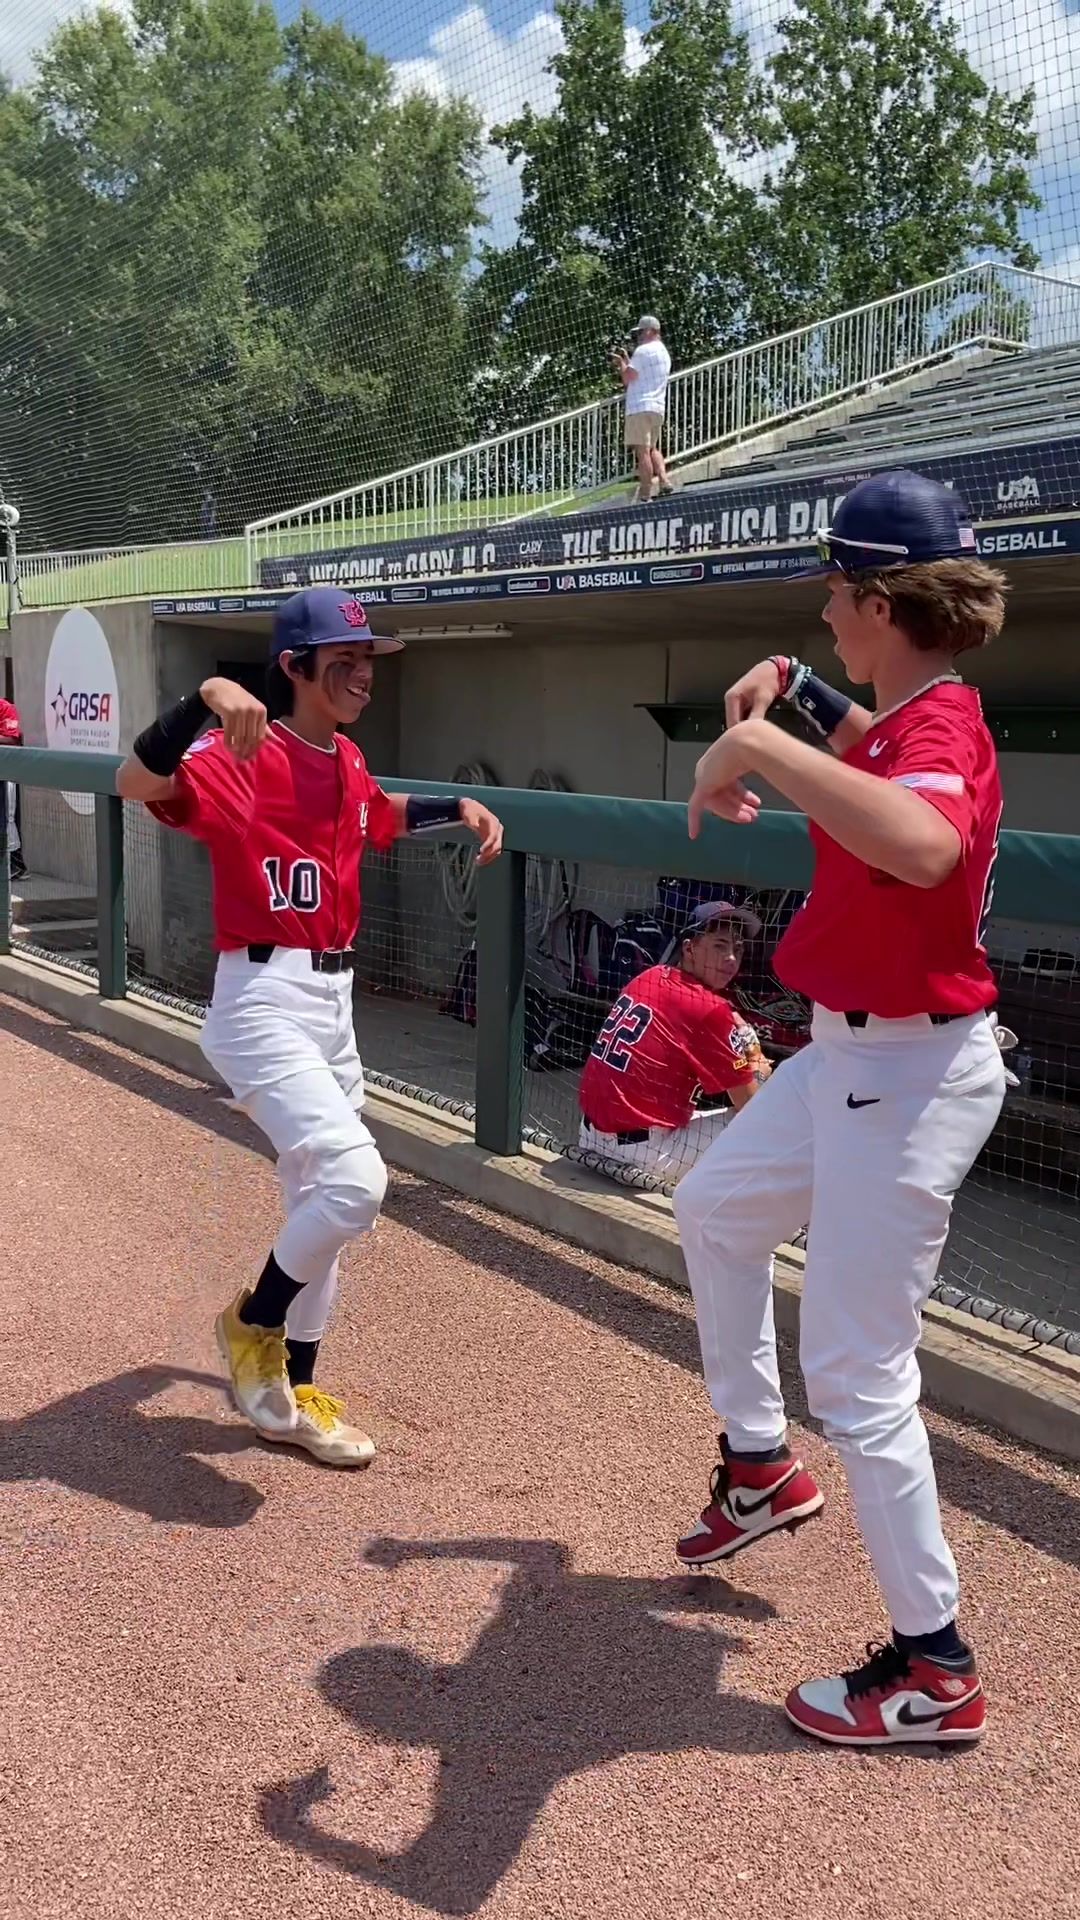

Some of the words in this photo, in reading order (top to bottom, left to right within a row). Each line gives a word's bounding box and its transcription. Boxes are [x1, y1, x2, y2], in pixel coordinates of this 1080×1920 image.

[997, 475, 1040, 501] USA
[997, 500, 1040, 510] BASEBALL
[519, 540, 543, 554] CARY
[562, 529, 603, 565] THE
[609, 518, 683, 561] HOME
[689, 523, 714, 552] OF
[721, 505, 777, 550] USA
[976, 530, 1067, 554] SEBALL
[310, 557, 385, 585] WELCOME
[388, 562, 402, 581] TO
[579, 571, 642, 588] BASEBALL
[352, 591, 387, 603] SEBALL
[69, 693, 111, 722] GRSA
[262, 857, 321, 913] 10
[591, 994, 653, 1072] 22
